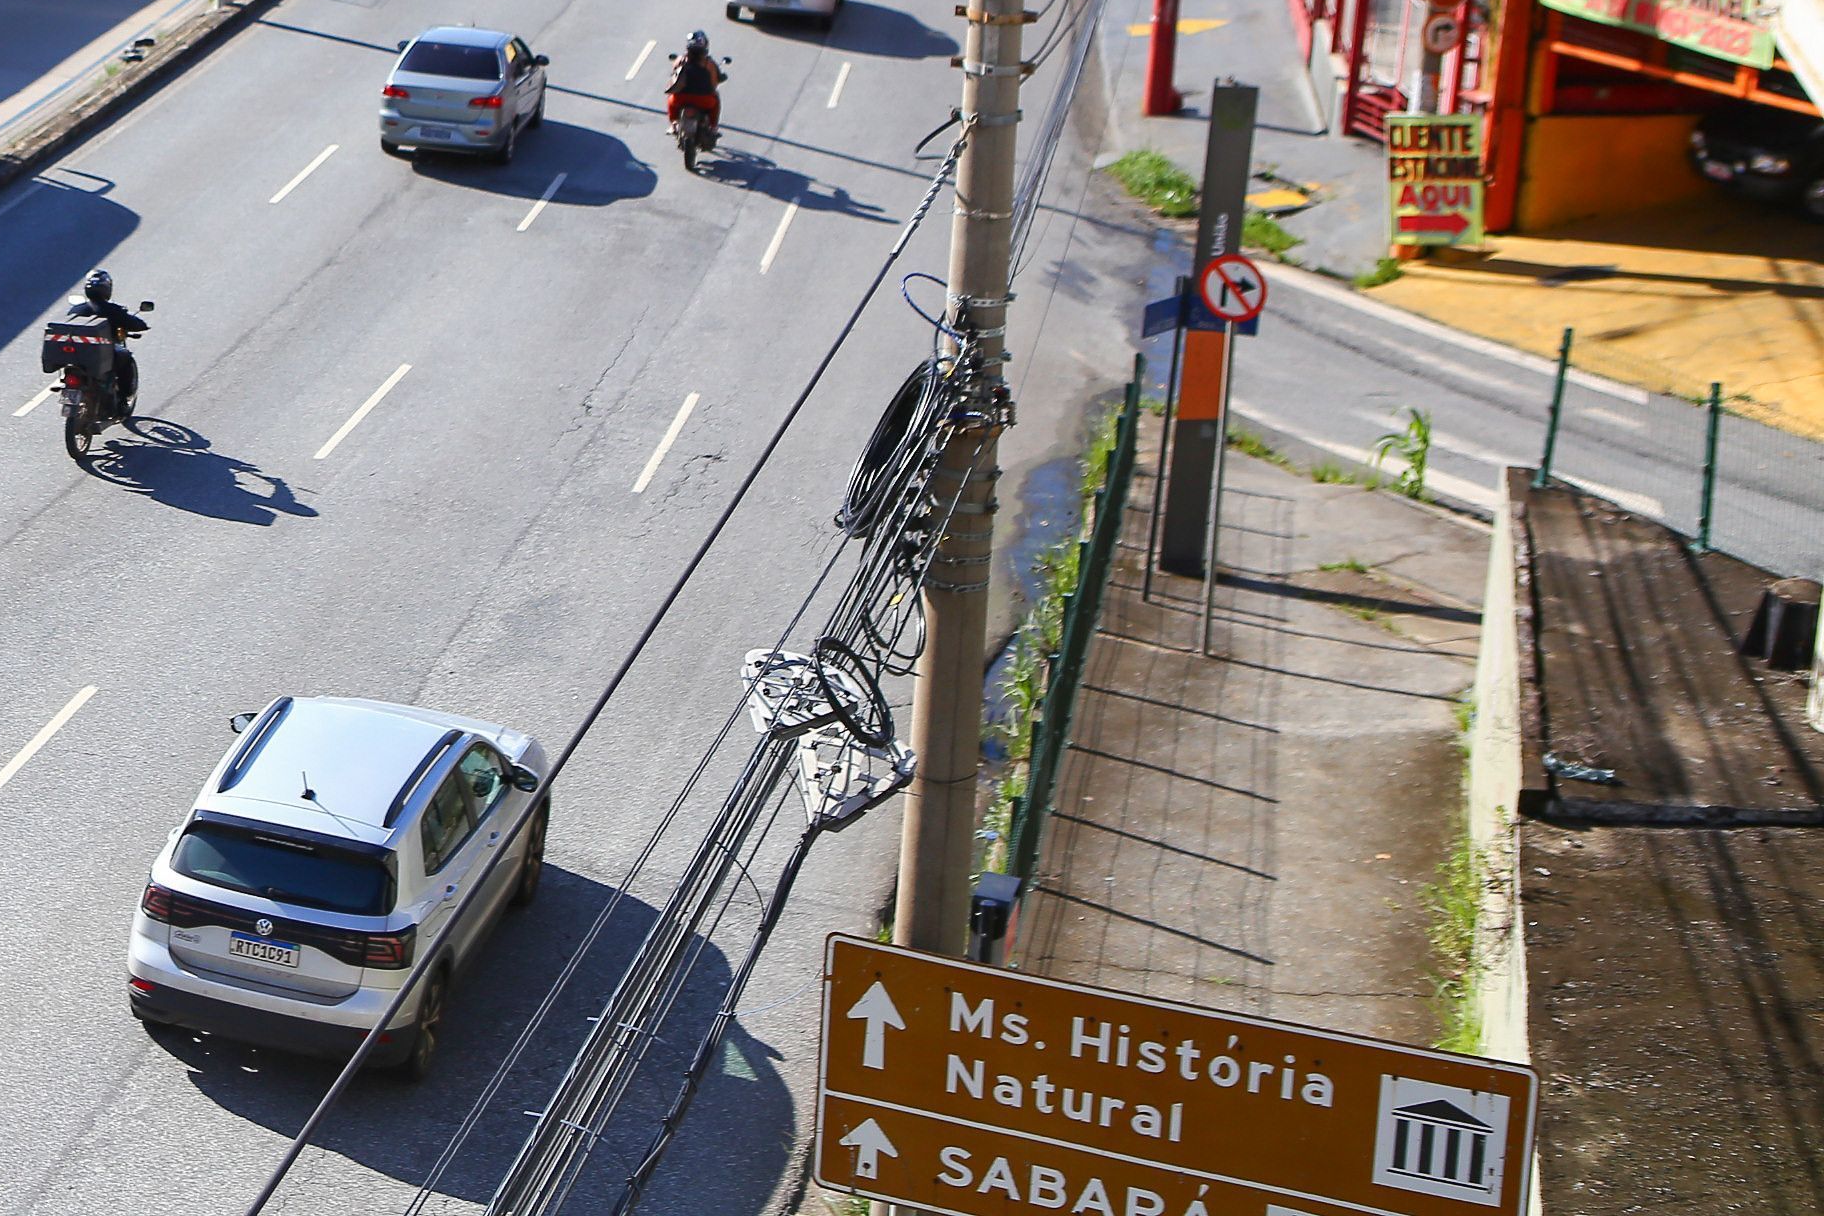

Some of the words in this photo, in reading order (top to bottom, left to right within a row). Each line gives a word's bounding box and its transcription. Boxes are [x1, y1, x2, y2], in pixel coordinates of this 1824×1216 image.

[1398, 184, 1472, 212] AQUI
[236, 939, 292, 963] RTC1C91
[948, 991, 1046, 1050] Ms.
[1069, 1016, 1334, 1109] História
[945, 1053, 1184, 1142] Natural
